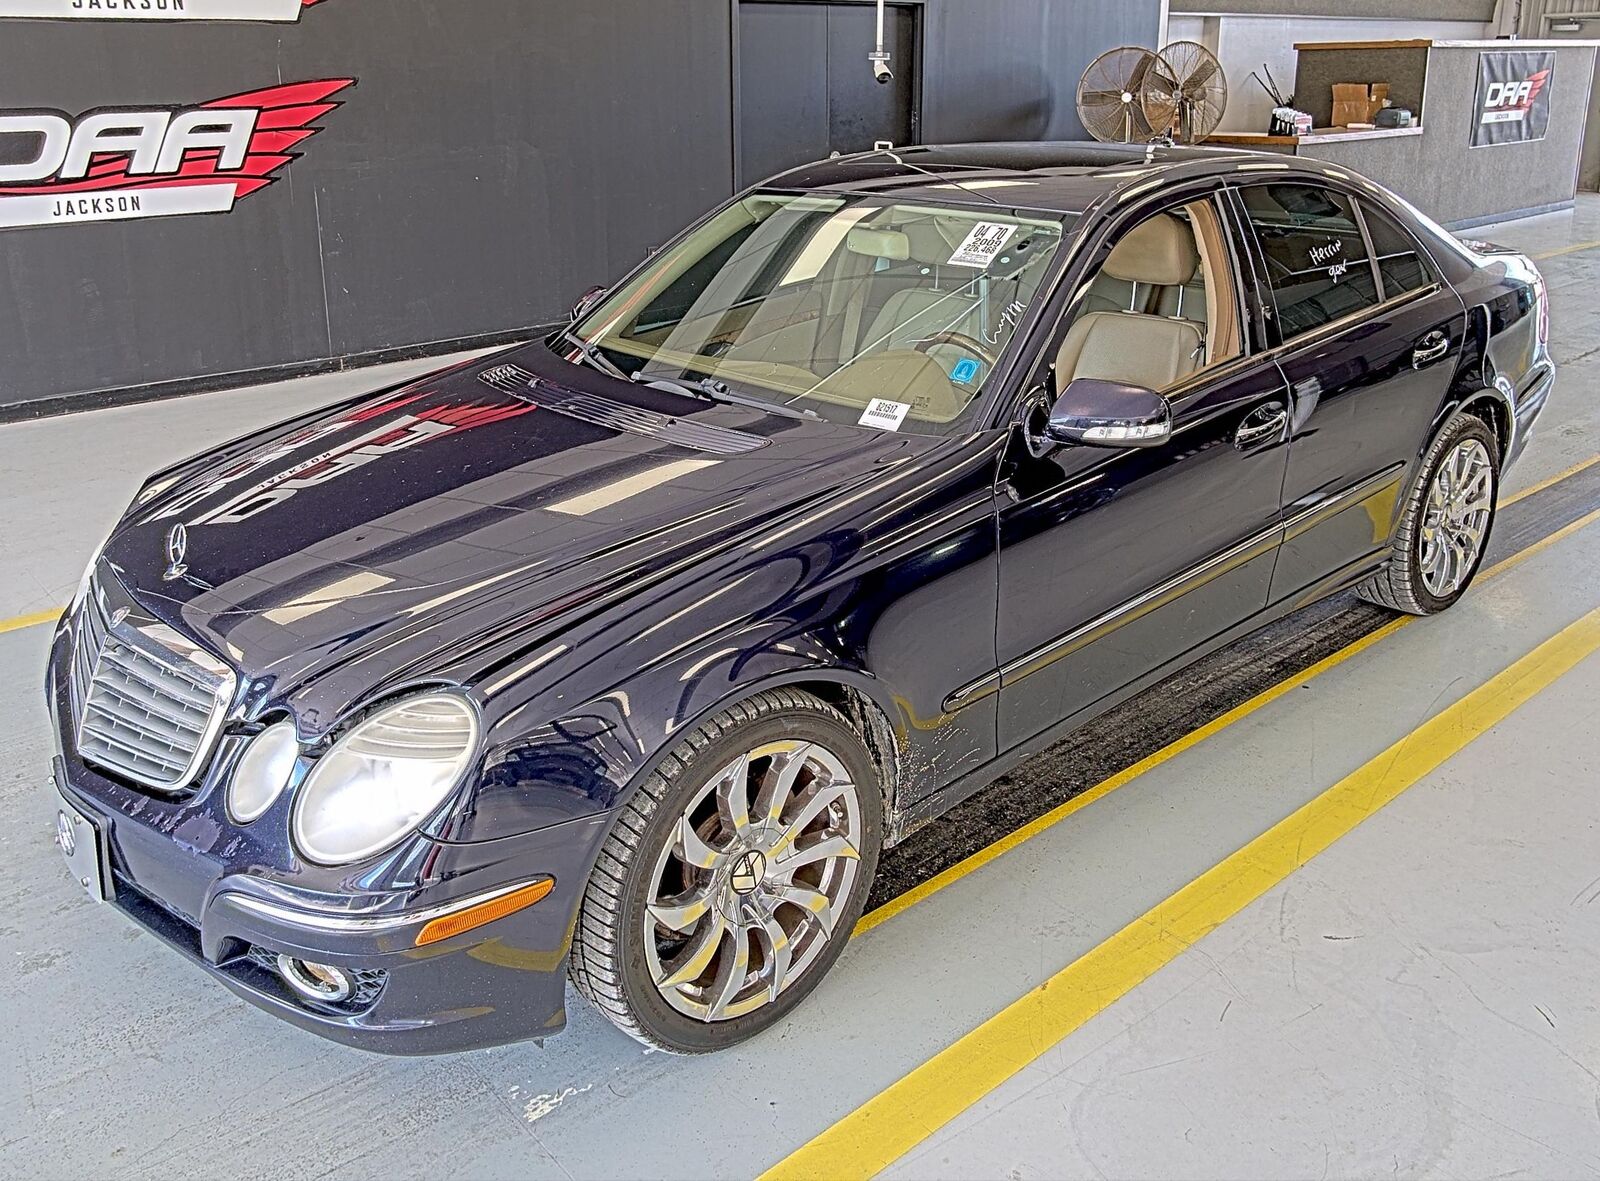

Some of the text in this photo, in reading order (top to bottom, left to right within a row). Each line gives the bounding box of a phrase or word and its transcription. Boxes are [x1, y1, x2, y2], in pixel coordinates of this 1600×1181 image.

[1484, 81, 1533, 107] DAA
[53, 196, 141, 216] JACKSON
[974, 225, 1009, 240] 04 70
[972, 237, 1002, 247] 2009
